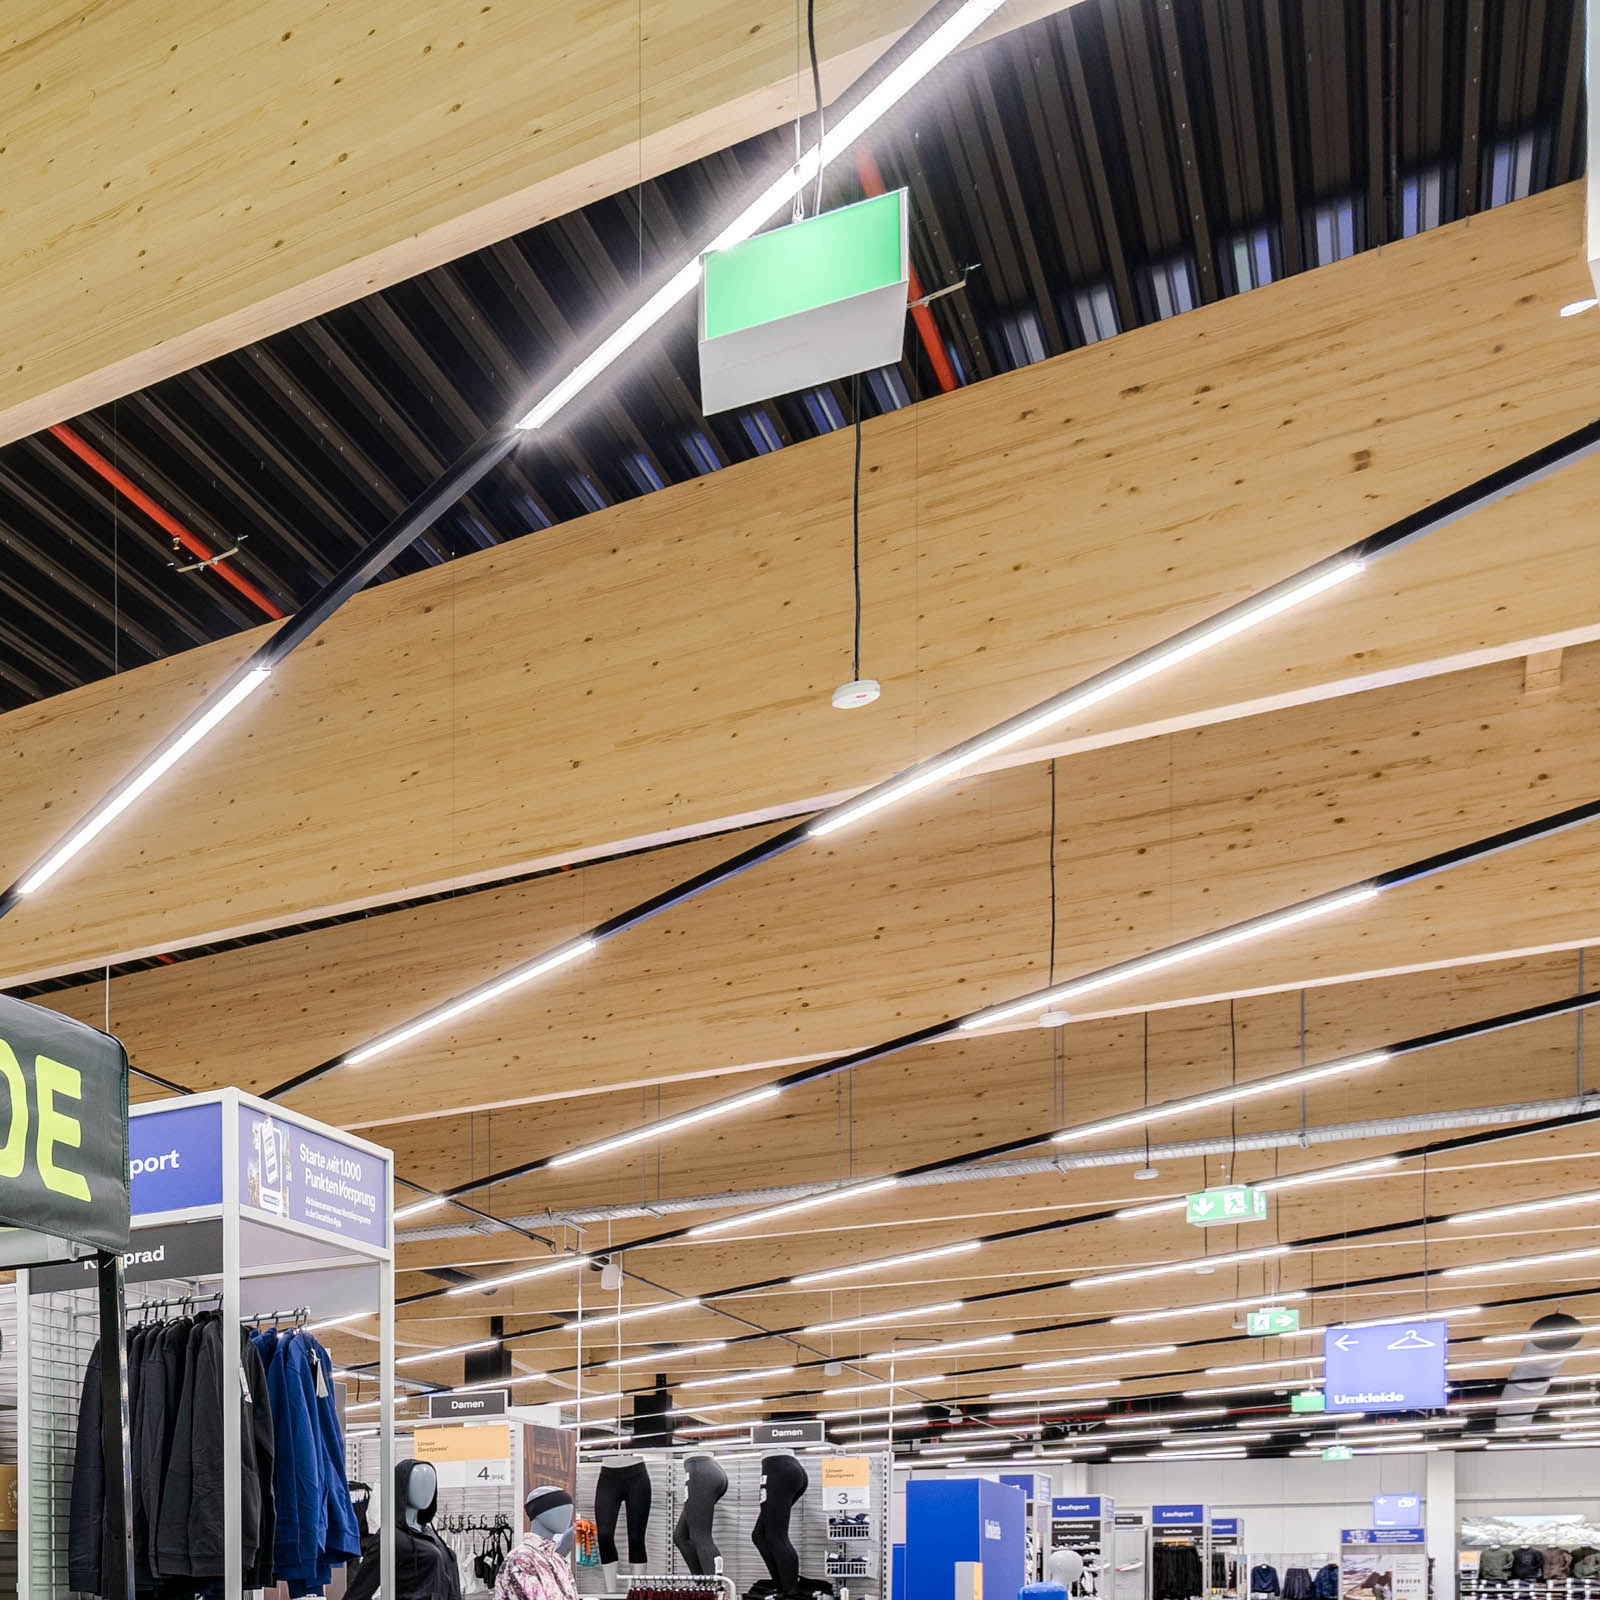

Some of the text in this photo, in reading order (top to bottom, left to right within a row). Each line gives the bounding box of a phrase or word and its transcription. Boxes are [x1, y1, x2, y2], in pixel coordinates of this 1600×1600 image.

[130, 1149, 180, 1180] port
[300, 1143, 326, 1170] Starte
[305, 1167, 340, 1196] Punkten
[338, 1179, 376, 1212] Vorsprung
[451, 1400, 484, 1410] Damen
[1334, 1392, 1404, 1404] Umkleide
[771, 1429, 804, 1438] Damen
